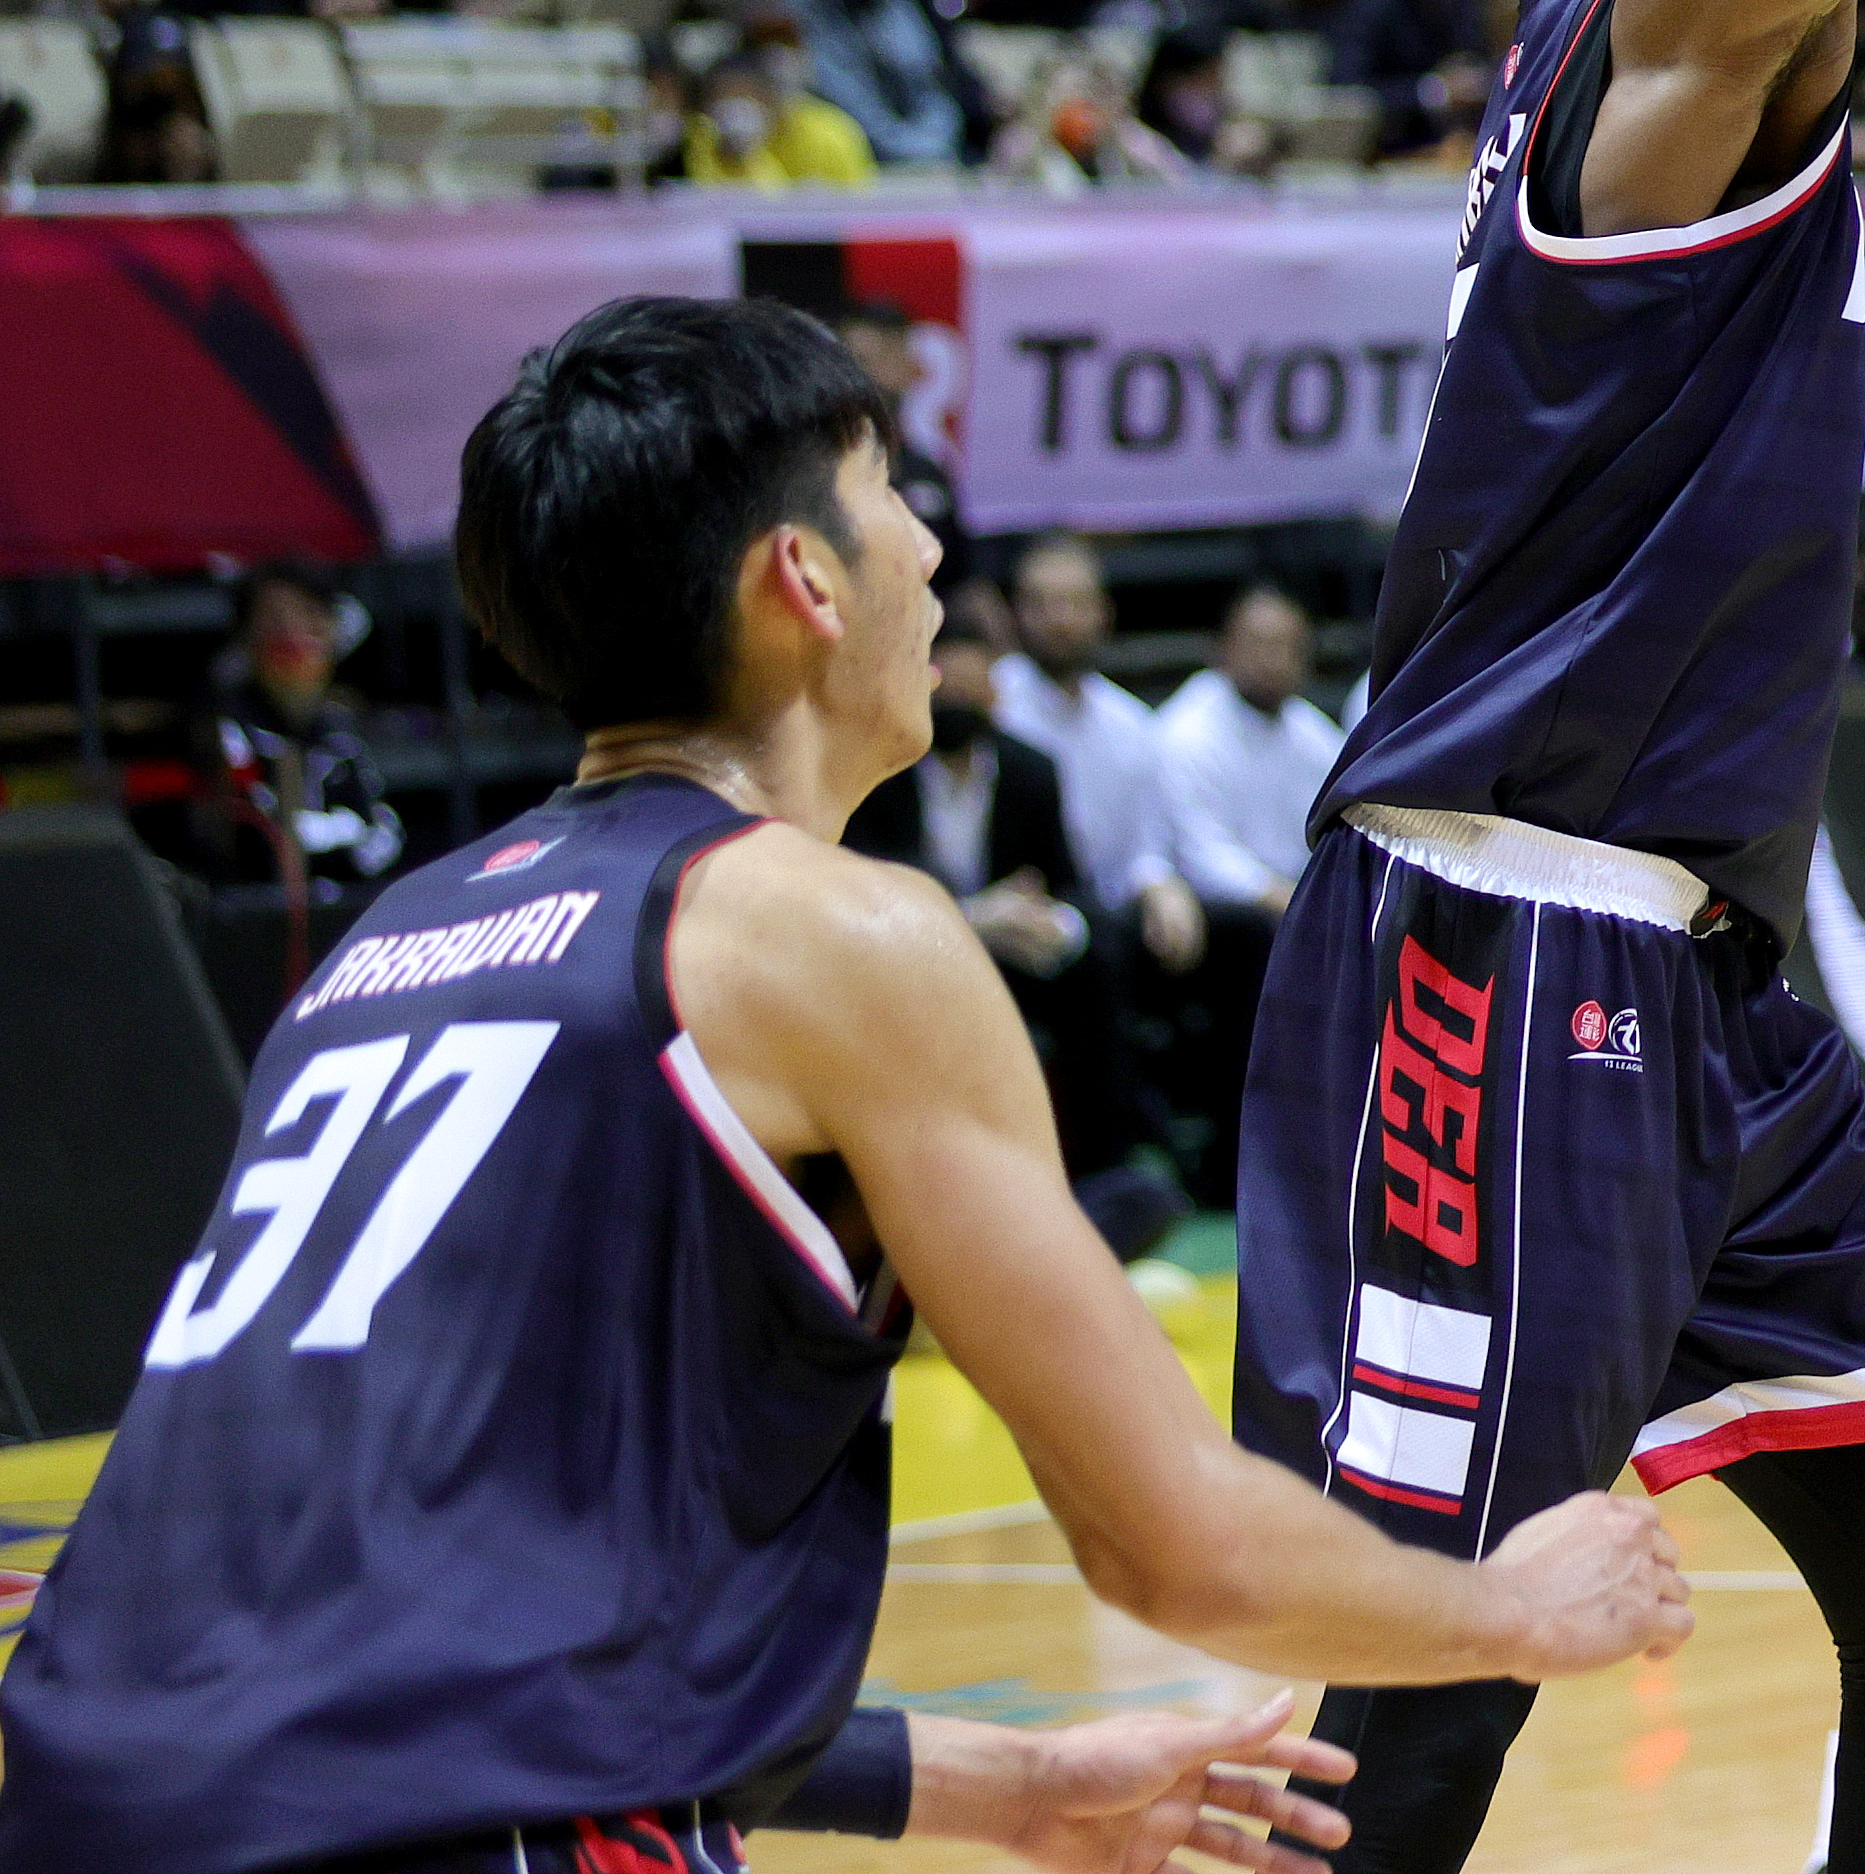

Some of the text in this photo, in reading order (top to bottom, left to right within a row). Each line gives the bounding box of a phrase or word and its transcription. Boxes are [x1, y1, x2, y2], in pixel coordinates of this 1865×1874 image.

[1013, 328, 1430, 456] TOYOT
[294, 889, 602, 1023] JAKRAWAN
[144, 1019, 562, 1372] 37
[1378, 932, 1495, 1268] DEA
